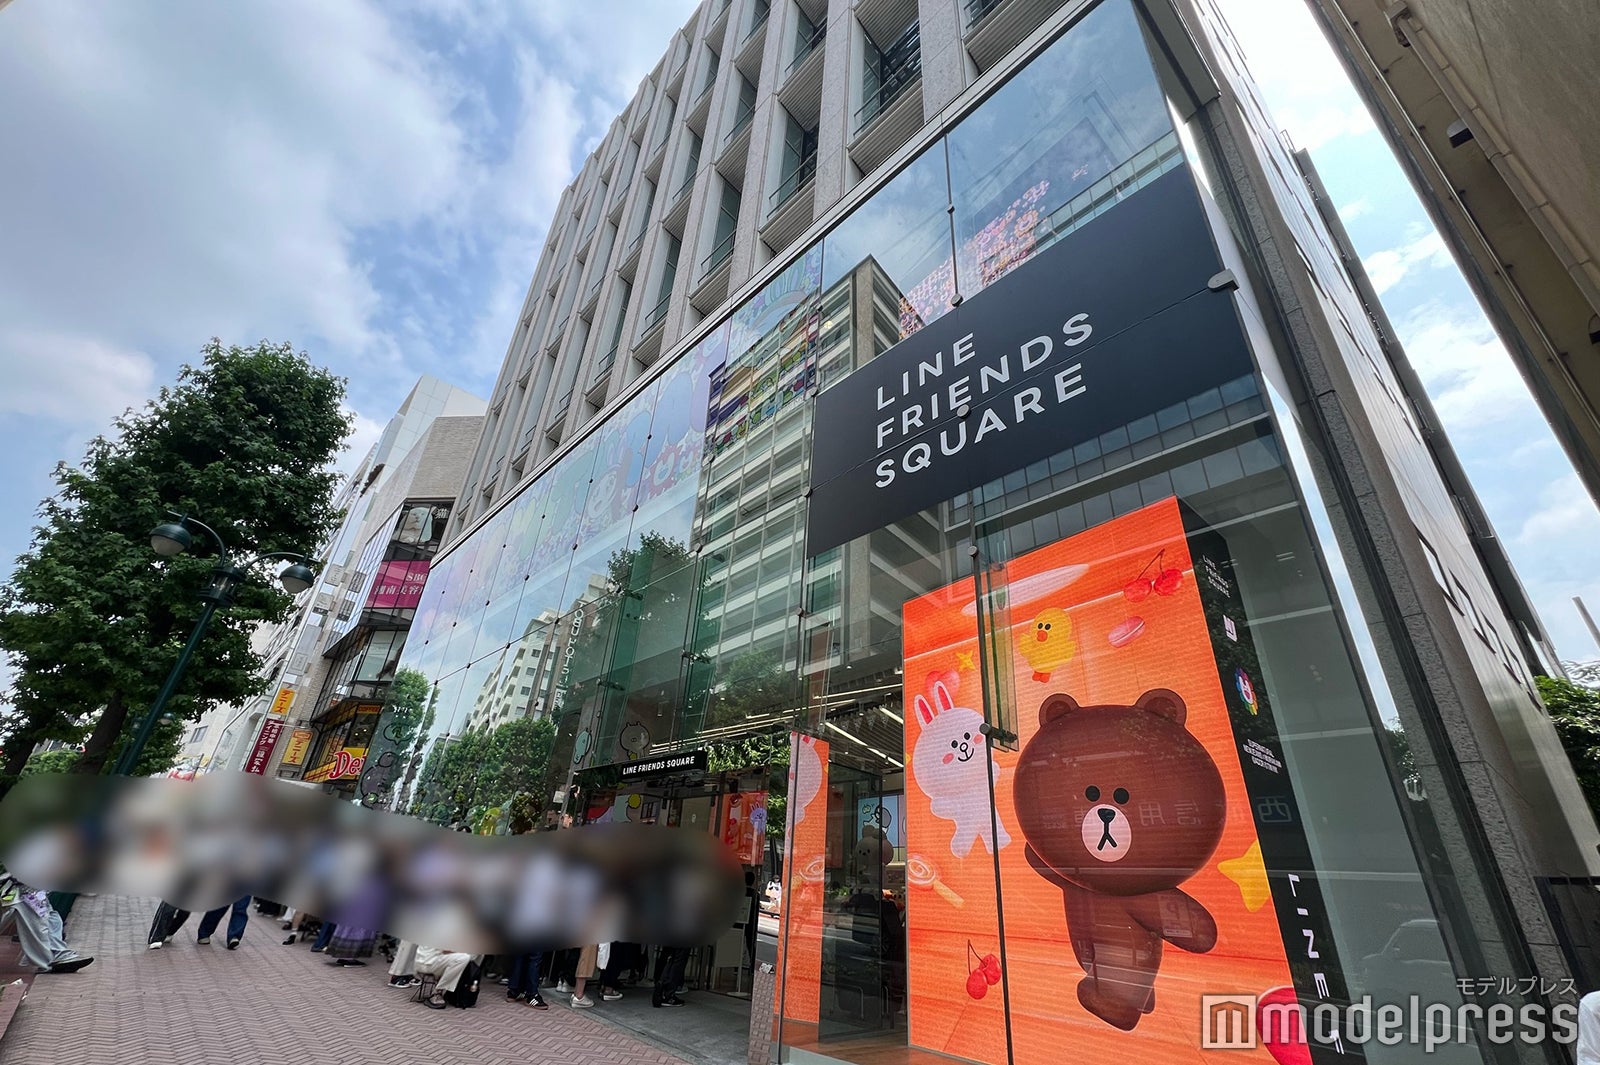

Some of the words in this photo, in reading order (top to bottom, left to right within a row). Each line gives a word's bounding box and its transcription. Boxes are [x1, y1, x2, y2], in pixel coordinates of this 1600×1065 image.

[876, 312, 1093, 449] FRIENDS
[877, 332, 976, 411] LINE
[875, 362, 1087, 488] SQUARE
[374, 584, 424, 595] 湘南美容
[622, 765, 638, 775] LINE
[637, 761, 665, 773] FRIENDS
[666, 756, 696, 768] SQUARE
[1288, 873, 1330, 999] LINE
